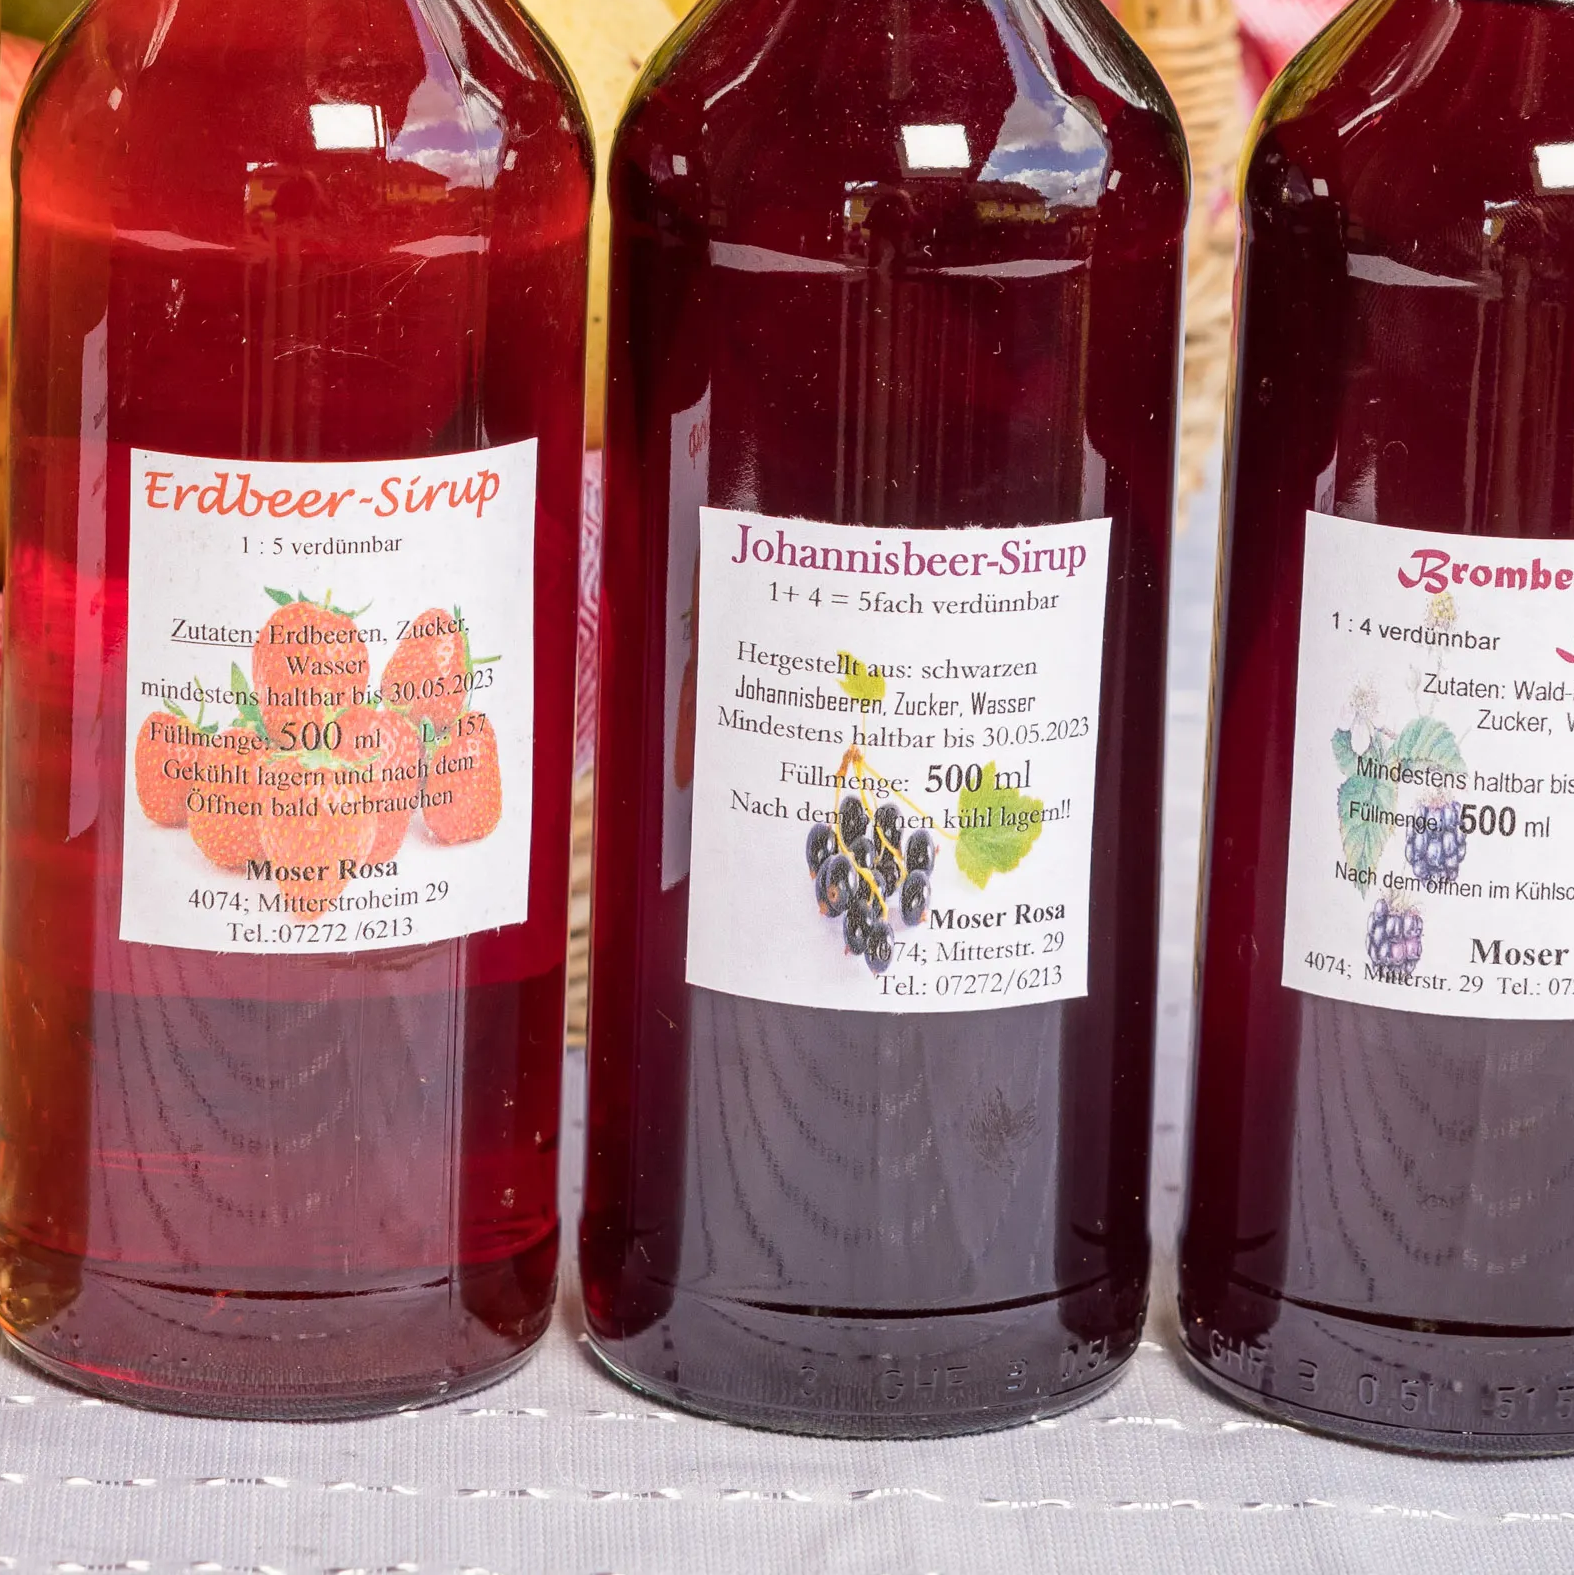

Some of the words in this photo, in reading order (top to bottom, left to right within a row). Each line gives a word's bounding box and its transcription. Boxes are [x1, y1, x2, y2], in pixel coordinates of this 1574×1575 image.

[144, 469, 501, 519] Erdbeer-Sirup
[273, 537, 283, 555] 5
[292, 536, 403, 555] verdünnbar
[731, 524, 1086, 578] Johannisbeer-Sirup
[809, 586, 822, 607] 4
[859, 591, 924, 614] 5fach
[933, 591, 1060, 614] verdünnbar
[171, 618, 260, 643] Zutaten:
[270, 623, 388, 647] Erdbeeren,
[396, 616, 469, 641] Zucker,
[1360, 618, 1372, 636] 4
[1379, 623, 1501, 651] verdünnbar
[286, 655, 367, 675] Wasser
[737, 641, 860, 677] Hergestellt
[867, 663, 912, 679] aus:
[921, 659, 1038, 680] schwarzen
[141, 680, 260, 706] mindestens
[267, 686, 345, 707] haltbar
[353, 686, 383, 705] bis
[389, 668, 494, 703] 30.05.2023
[735, 675, 887, 716] Johannisbeeren,
[894, 692, 963, 718] Zucker,
[971, 692, 1036, 715] Wasser
[1423, 674, 1505, 700] Zutaten:
[150, 722, 270, 752] Füllmenge:
[279, 722, 342, 751] 500
[354, 729, 381, 749] ml
[456, 713, 487, 737] 157
[717, 706, 844, 745] Mindestens
[852, 725, 936, 749] haltbar
[944, 728, 975, 749] bis
[982, 717, 1090, 748] 30.05.2023
[1477, 710, 1552, 735] Zucker,
[163, 760, 248, 785] Gekühlt
[258, 765, 325, 791] lagern
[334, 764, 374, 786] und
[382, 757, 428, 783] nach
[435, 753, 474, 775] dem
[780, 761, 909, 798] Füllmenge:
[925, 764, 983, 793] 500
[993, 761, 1031, 790] ml
[1356, 756, 1467, 790] Mindestens
[1473, 771, 1544, 794] haltbar
[186, 788, 262, 817] Öffnen
[272, 796, 319, 817] bald
[328, 789, 454, 816] verbrauchen
[731, 789, 788, 819] Nach
[944, 809, 992, 830] kühl
[999, 799, 1072, 832] lagern!!
[1458, 804, 1516, 837] 500
[1524, 817, 1550, 838] ml
[246, 859, 330, 881] Moser
[339, 858, 398, 879] Rosa
[1335, 861, 1377, 886] Nach
[1383, 871, 1421, 892] dem
[1426, 876, 1482, 898] öffnen
[1488, 882, 1510, 899] im
[188, 889, 251, 915] 4074;
[258, 890, 419, 912] Mitterstroheim
[425, 881, 449, 902] 29
[929, 907, 1007, 931] Moser
[1015, 903, 1066, 926] Rosa
[937, 939, 1036, 963] Mitterstr.
[1043, 931, 1064, 953] 29
[1469, 938, 1570, 966] Moser
[878, 974, 927, 996] Tel.:
[935, 964, 1062, 996] 07272/6213
[1304, 950, 1352, 980] 4074;
[1459, 976, 1483, 993] 29
[1496, 977, 1542, 996] Tel.:
